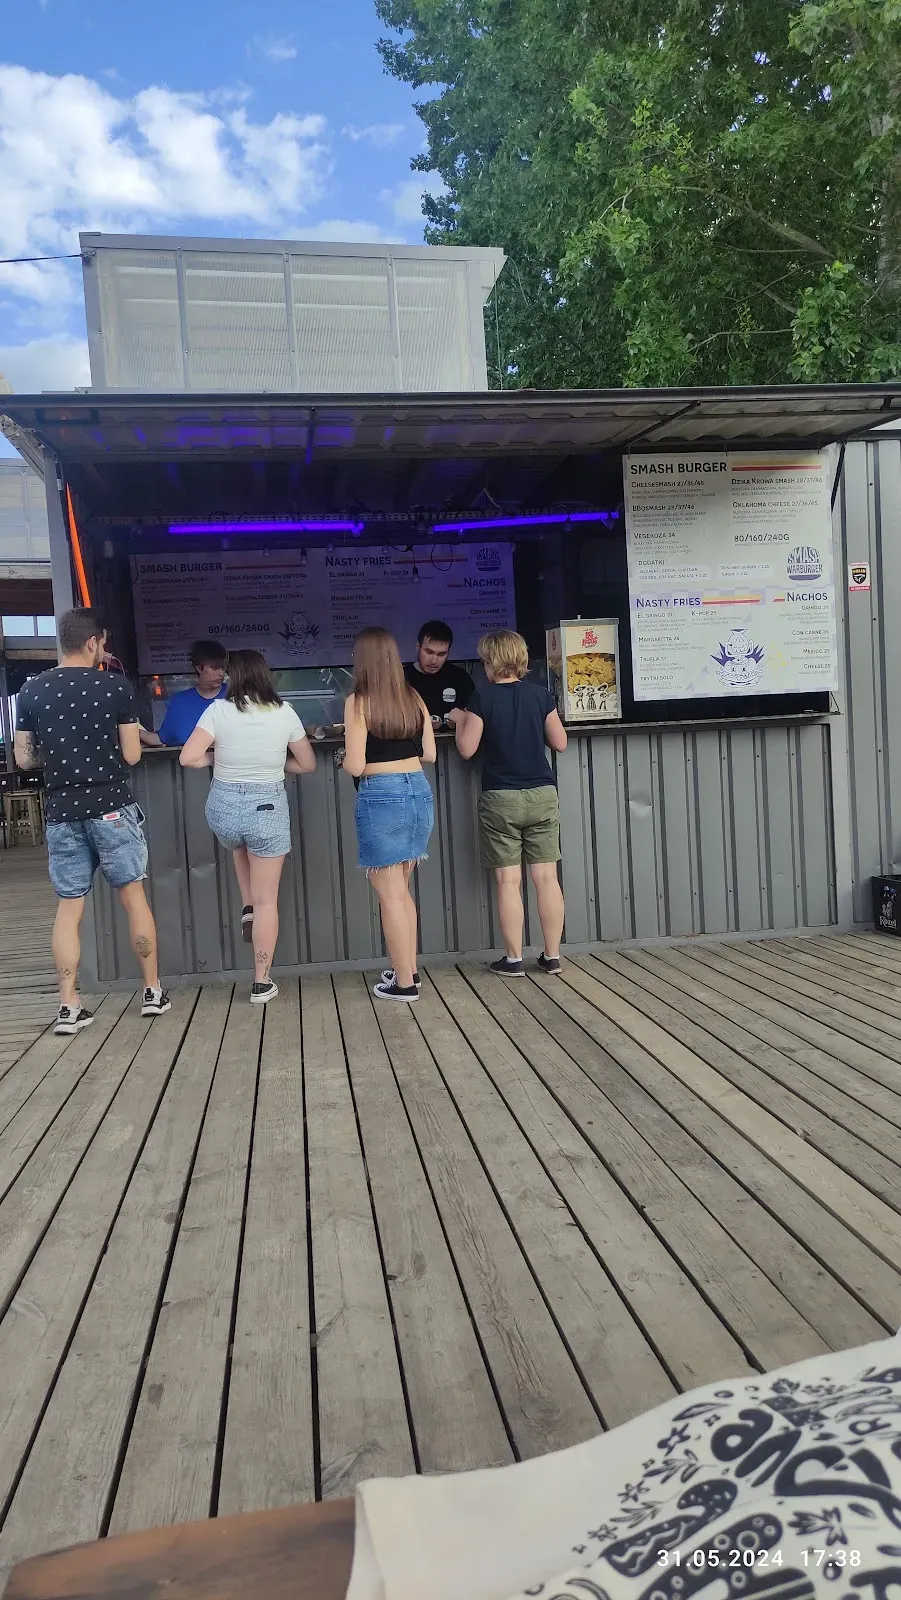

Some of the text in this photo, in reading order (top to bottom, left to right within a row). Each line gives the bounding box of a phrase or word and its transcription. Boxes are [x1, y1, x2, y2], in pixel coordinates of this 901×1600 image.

[630, 462, 727, 475] SMASH BURGER
[751, 477, 774, 485] KROWA
[733, 532, 790, 543] 80/160/240G
[787, 546, 821, 564] SMASH
[325, 556, 391, 567] NASTY FRIES
[140, 562, 223, 574] SMASH BURGER
[785, 563, 823, 574] WARBURGER
[463, 577, 507, 588] NACHOS
[636, 597, 701, 608] NASTY FRIES
[787, 592, 828, 602] NACHOS
[208, 623, 270, 634] 80/160/240G
[879, 915, 897, 929] Kozel
